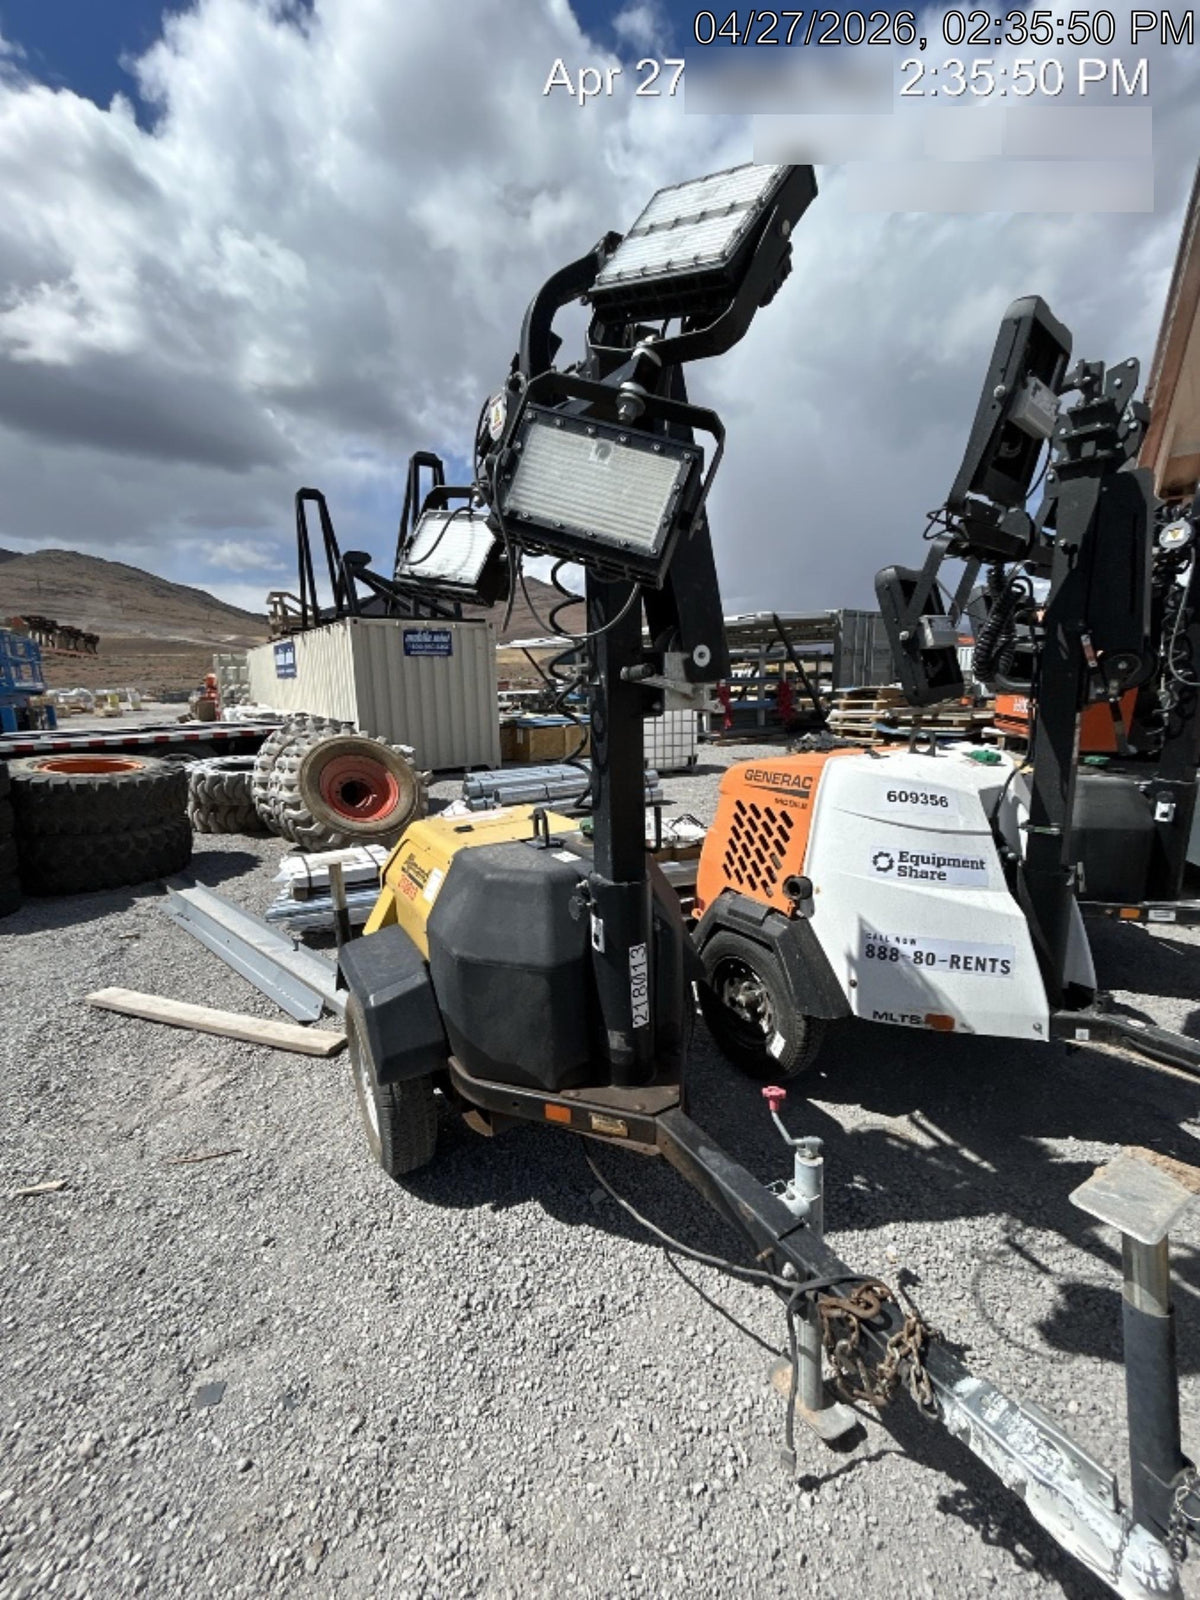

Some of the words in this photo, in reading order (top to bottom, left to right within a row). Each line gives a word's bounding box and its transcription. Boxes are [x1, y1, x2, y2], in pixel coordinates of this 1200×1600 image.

[744, 768, 813, 790] GENERAC
[886, 790, 949, 809] 609356
[897, 851, 986, 871] Equipment
[896, 865, 947, 882] Share
[865, 943, 1012, 976] 888-80-RENTS
